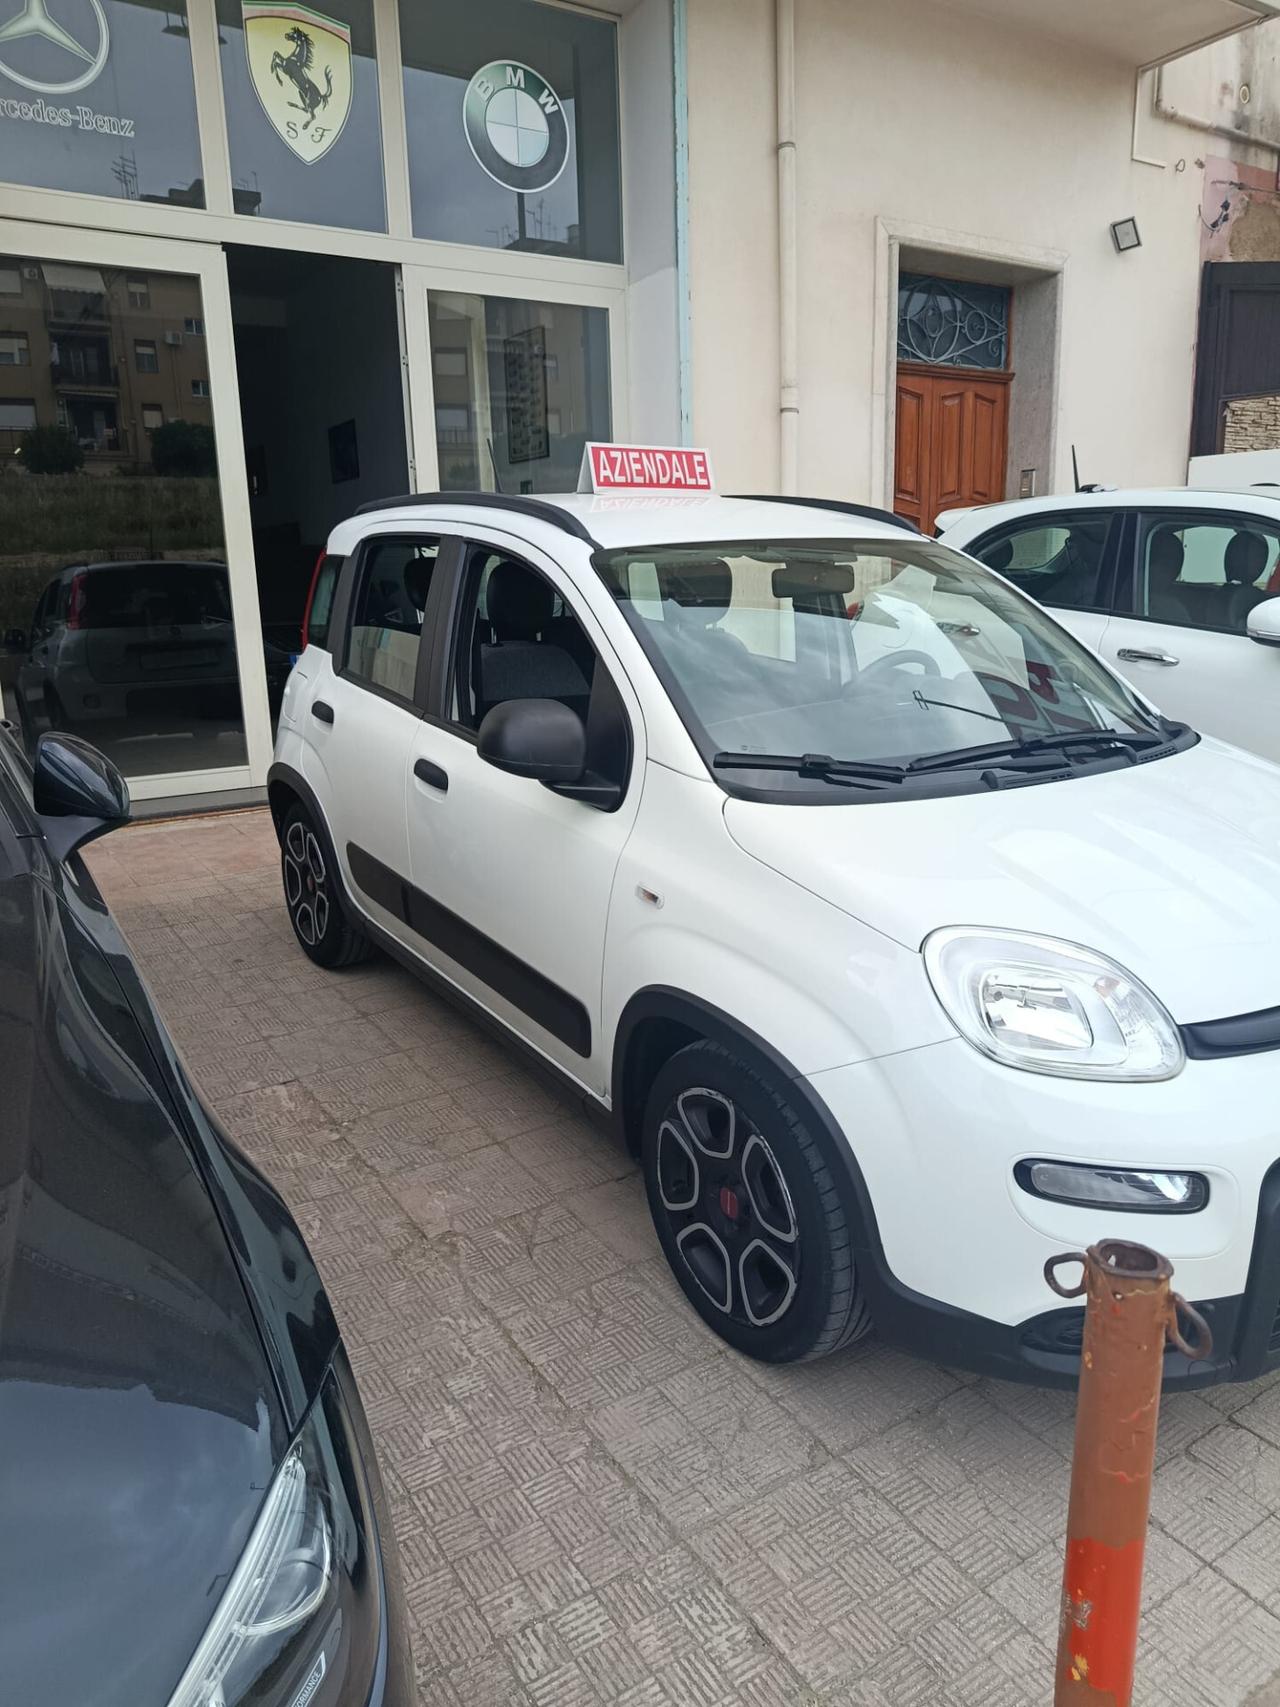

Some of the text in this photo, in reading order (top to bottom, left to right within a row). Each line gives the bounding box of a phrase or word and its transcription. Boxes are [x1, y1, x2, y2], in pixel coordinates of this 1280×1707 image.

[474, 65, 559, 115] BMW
[286, 121, 333, 143] S F
[600, 450, 708, 486] AZIENDALE
[295, 1670, 321, 1707] ORMANCE
